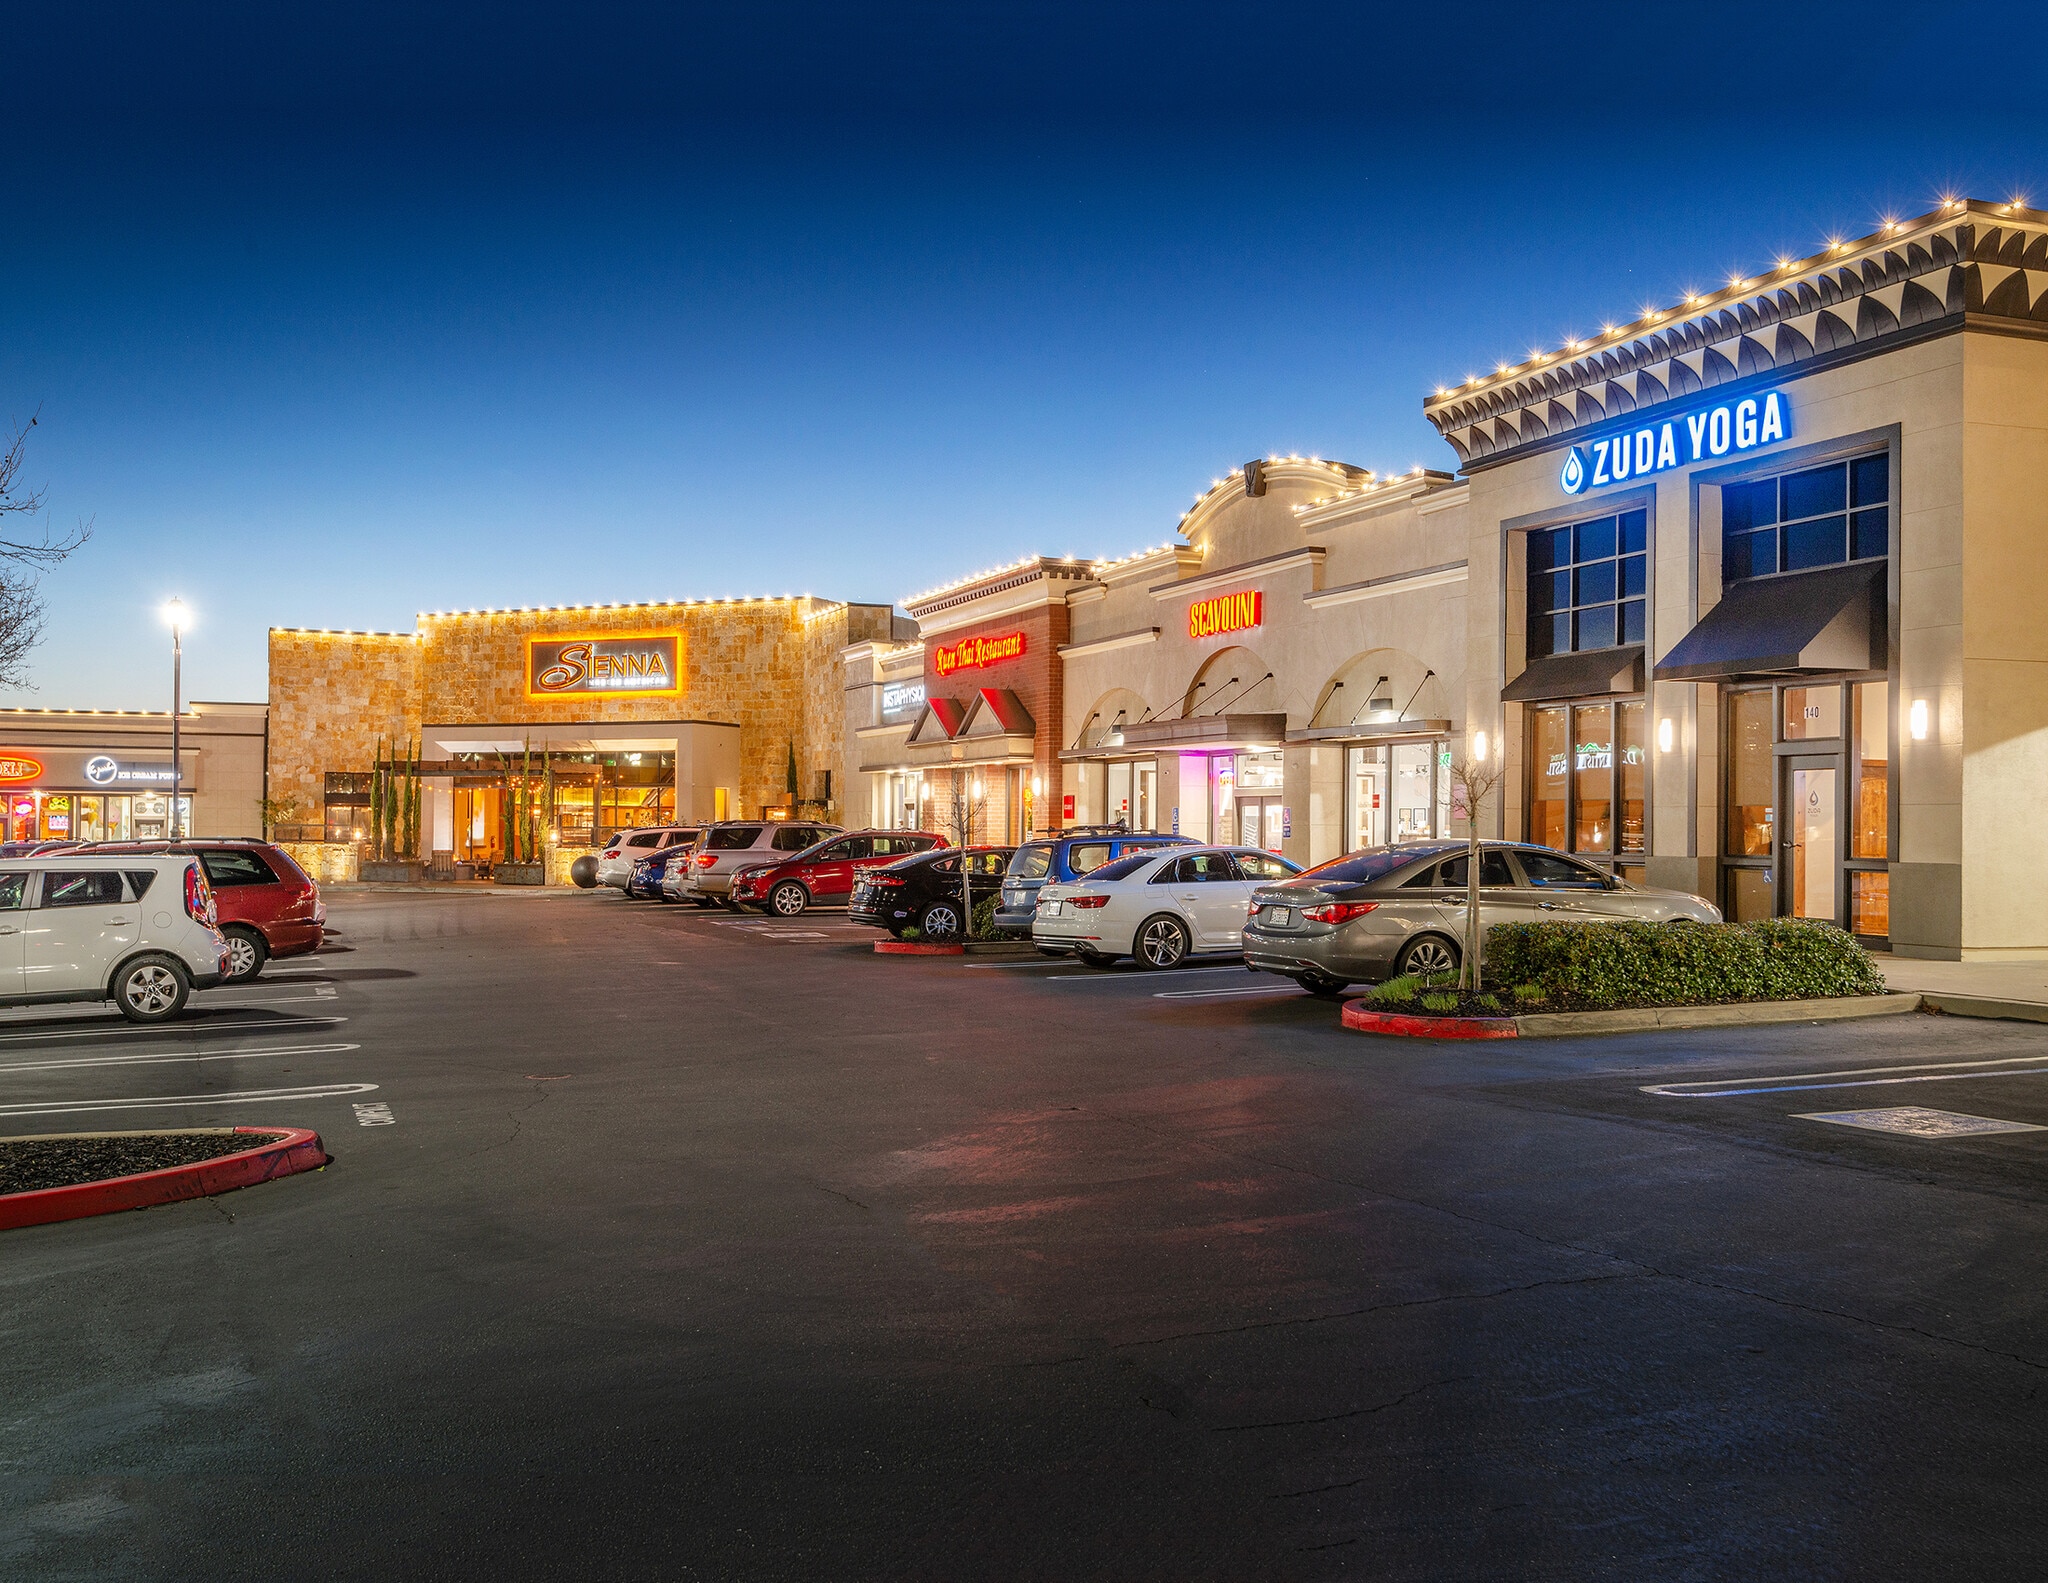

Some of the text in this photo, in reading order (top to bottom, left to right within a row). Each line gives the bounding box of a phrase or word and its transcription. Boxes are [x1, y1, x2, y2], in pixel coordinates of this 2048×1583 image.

[1592, 392, 1784, 486] ZUDA YOGA
[1190, 590, 1255, 638] SCAVOLINI
[957, 639, 974, 667] Thai
[975, 631, 1022, 668] Restaurant
[1805, 706, 1819, 718] 140
[0, 762, 23, 777] ELI
